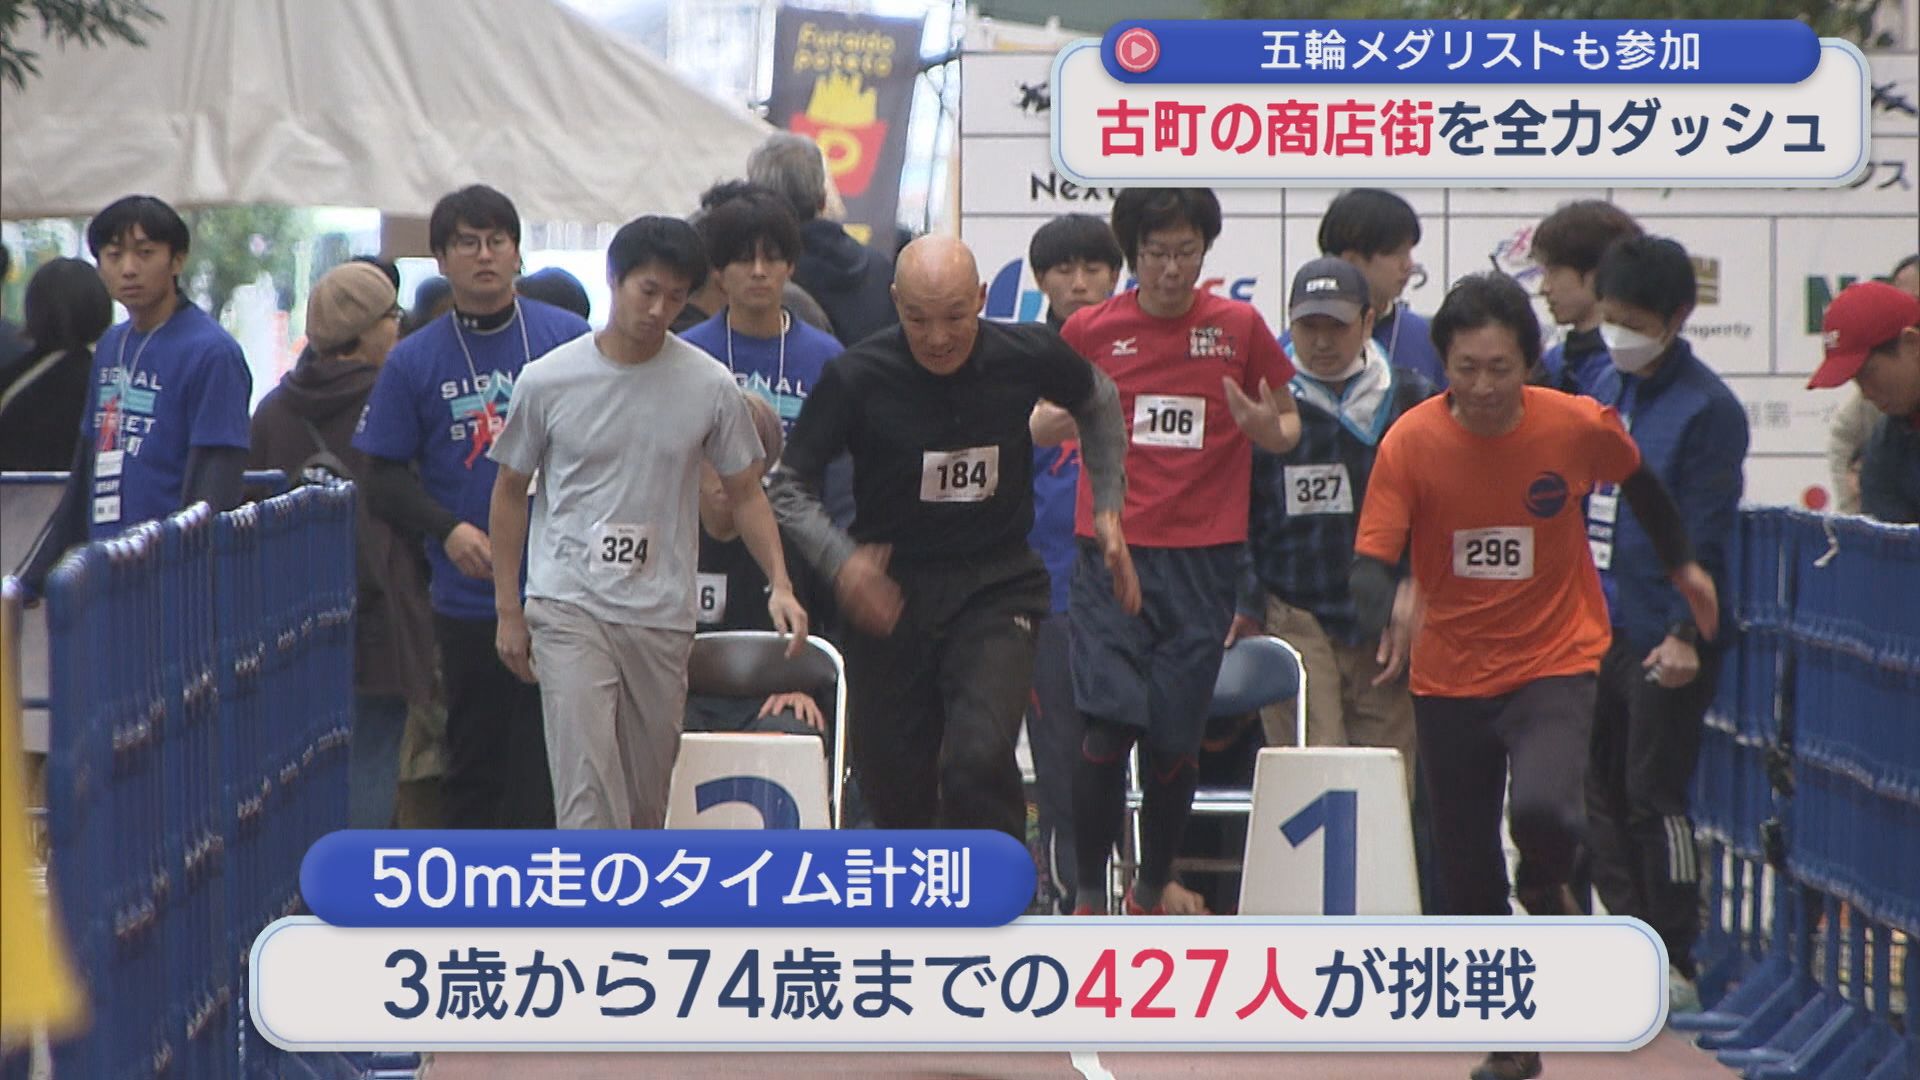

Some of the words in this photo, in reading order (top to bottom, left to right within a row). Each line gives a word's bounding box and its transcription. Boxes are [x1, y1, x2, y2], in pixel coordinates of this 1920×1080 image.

[440, 371, 514, 400] SIGN
[1147, 408, 1194, 434] 106
[936, 461, 987, 490] 184
[1296, 476, 1342, 502] 327
[602, 536, 648, 565] 324
[1466, 538, 1521, 567] 296
[700, 585, 715, 610] 6
